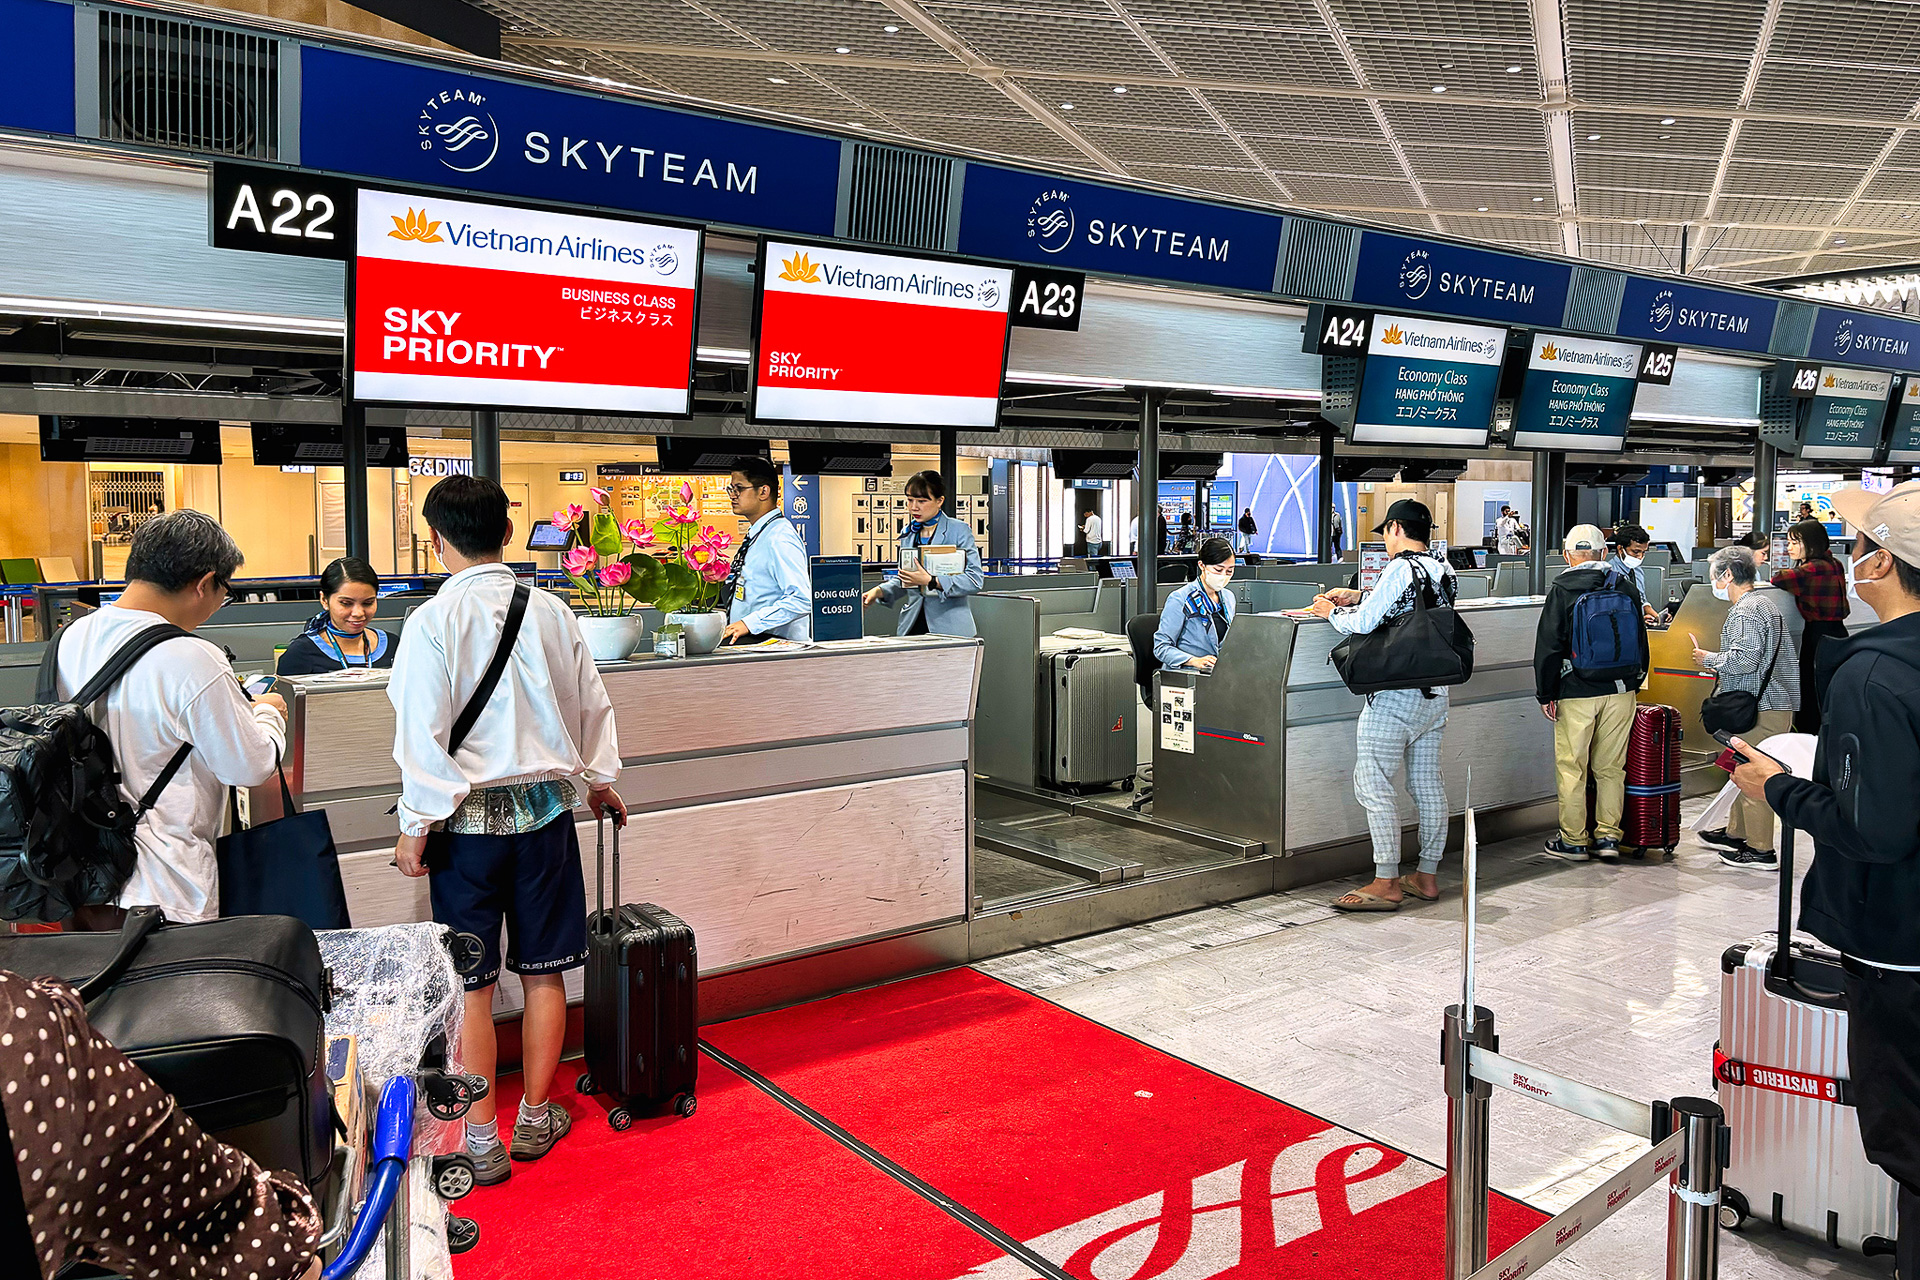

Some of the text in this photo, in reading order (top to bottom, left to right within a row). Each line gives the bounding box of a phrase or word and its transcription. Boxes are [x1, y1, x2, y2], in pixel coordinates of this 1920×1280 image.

[524, 132, 757, 194] SKYTEAM
[227, 184, 334, 240] A22
[446, 221, 645, 266] Vietnam Airlines
[1088, 219, 1229, 262] SKYTEAM
[823, 263, 974, 299] Vietnam Airlines
[1439, 272, 1535, 304] SKYTEAM
[562, 288, 676, 309] BUSINESS CLASS
[1019, 280, 1075, 318] A23
[384, 307, 461, 336] SKY
[580, 307, 674, 327] ビジネスクラス
[1678, 308, 1749, 334] SKYTEAM
[1323, 316, 1365, 347] A24
[1404, 331, 1445, 349] Vietnam
[1445, 337, 1483, 354] Airlines
[1856, 334, 1909, 355] SKYTEAM
[769, 351, 801, 365] SKY
[1558, 348, 1592, 364] Vietnam
[1592, 352, 1622, 368] Airlines
[1643, 351, 1673, 377] A25
[1398, 366, 1467, 387] Economy Class
[1792, 368, 1818, 391] A26
[1834, 377, 1859, 390] Vietnam
[1858, 380, 1878, 392] Airlines
[1552, 379, 1609, 397] Economy Class
[1395, 406, 1457, 421] エコノミークラス
[1829, 403, 1867, 417] Economy Class
[1549, 415, 1599, 429] エコノミークラス
[565, 472, 583, 480] 8:03
[821, 604, 853, 615] CLOSED
[1513, 1072, 1529, 1083] SKY
[1753, 1068, 1818, 1095] HYSTERIC
[1556, 1226, 1566, 1239] SKY
